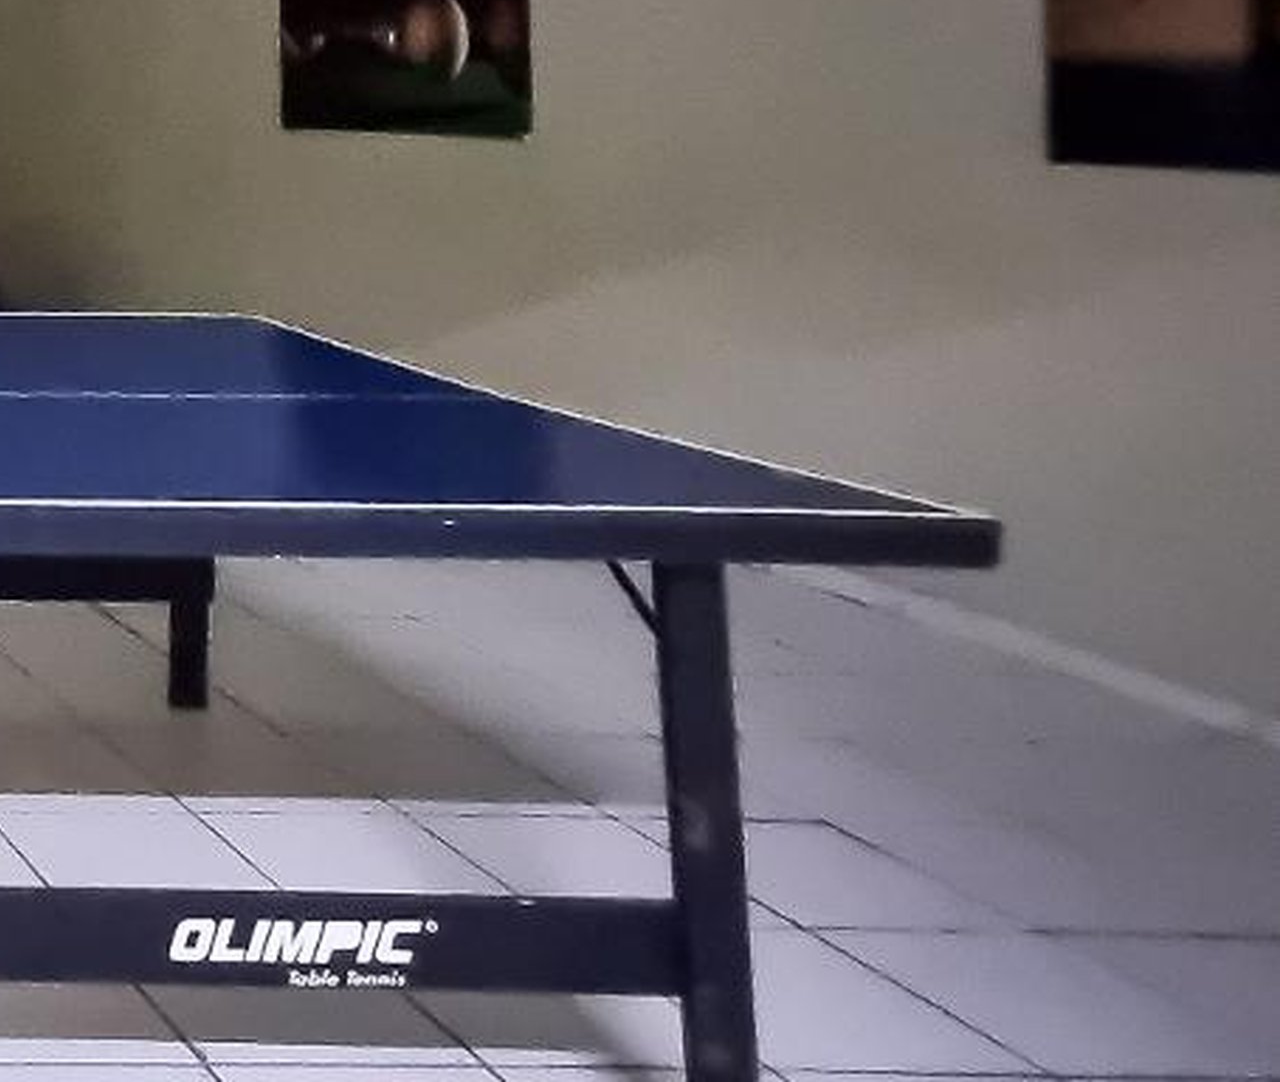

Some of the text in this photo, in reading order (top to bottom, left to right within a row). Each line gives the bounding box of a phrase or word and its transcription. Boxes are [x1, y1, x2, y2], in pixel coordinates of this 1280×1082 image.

[169, 918, 422, 964] OLIMPIC
[289, 970, 406, 987] Table Tennis
